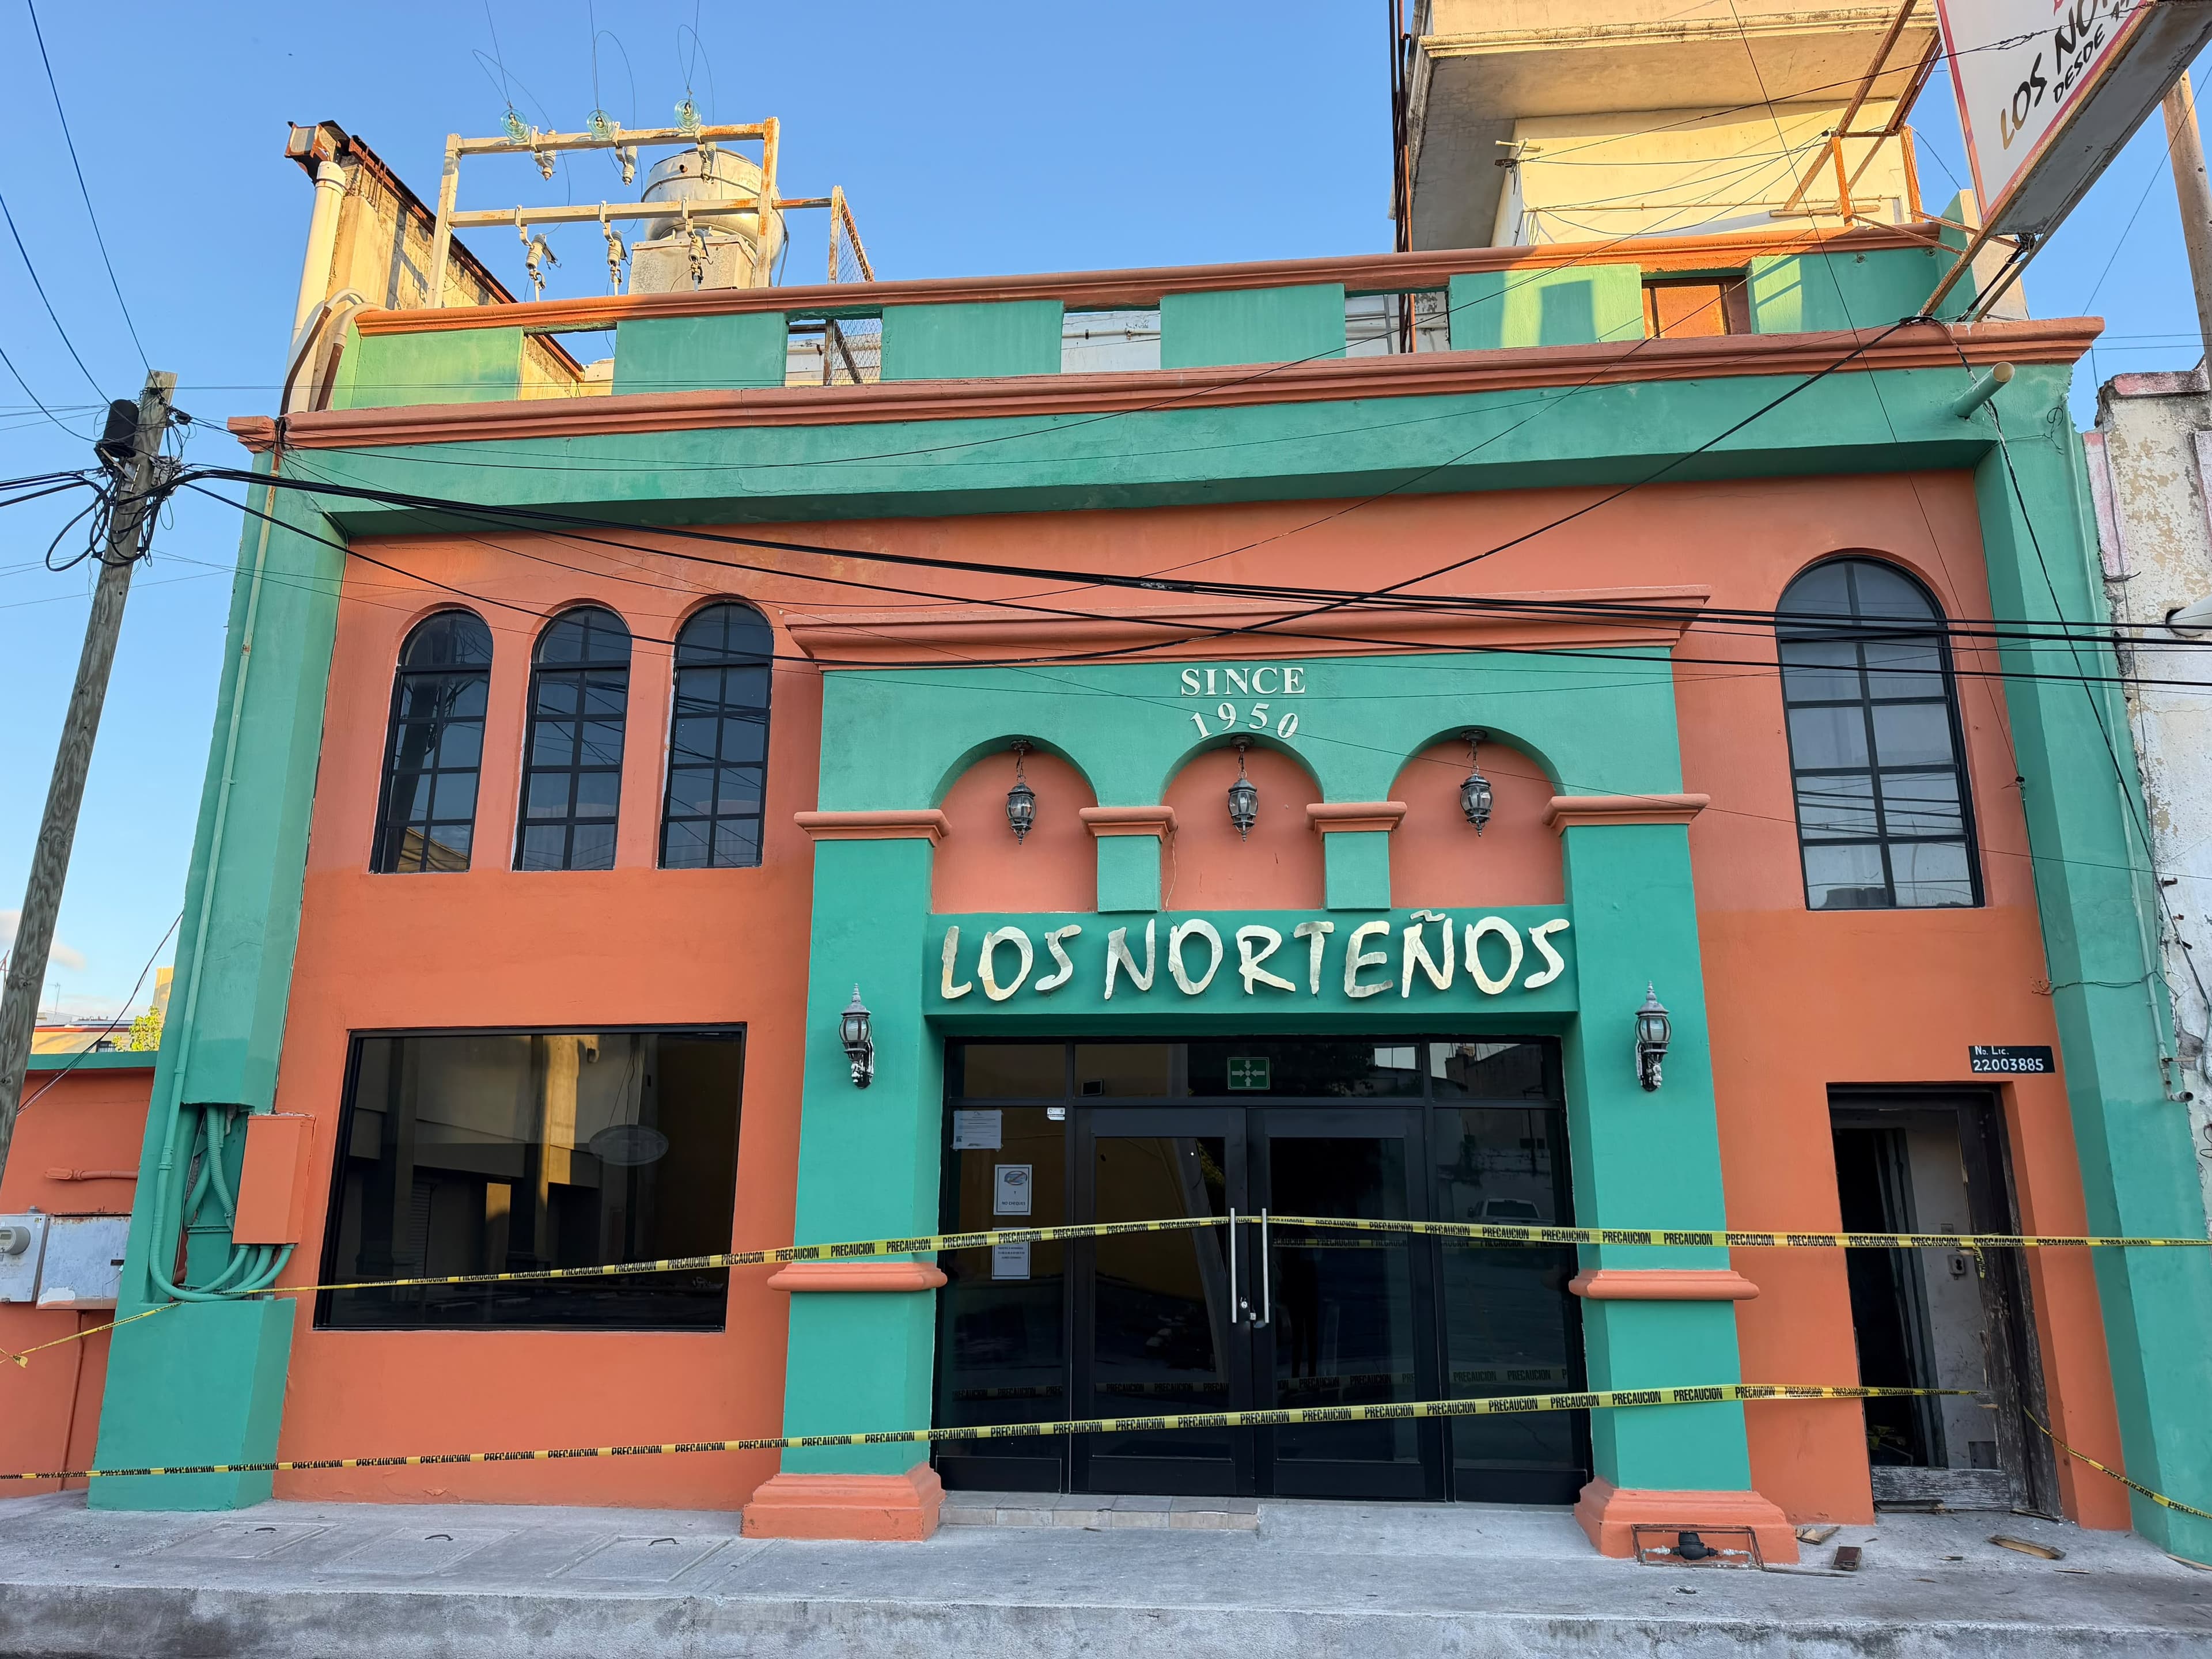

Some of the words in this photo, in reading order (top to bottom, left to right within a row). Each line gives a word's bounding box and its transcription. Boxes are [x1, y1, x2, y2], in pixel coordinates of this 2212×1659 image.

[2052, 23, 2105, 103] DESDE
[2001, 52, 2047, 150] LOS
[1181, 666, 1306, 696] SINCE
[1190, 702, 1299, 740] 1950
[941, 924, 1082, 1001] LOS
[1104, 908, 1570, 1001] NORTEÑOS
[1973, 1058, 2044, 1071] 22003885
[614, 1261, 657, 1272] PRECAUCION
[667, 1256, 710, 1269] PRECAUCION
[721, 1251, 764, 1266] PRECAUCION
[775, 1247, 819, 1261] PRECAUCION
[831, 1243, 875, 1257] PRECAUCION
[886, 1238, 931, 1252] PRECAUCION
[942, 1234, 987, 1249] PRECAUCION
[998, 1230, 1042, 1244] PRECAUCION
[1052, 1226, 1096, 1238] PRECAUCION
[1106, 1224, 1149, 1234] PRECAUCION
[1369, 1222, 1413, 1232] PRECAUCION
[1425, 1224, 1470, 1236] PRECAUCION
[1482, 1226, 1529, 1240] PRECAUCION
[1541, 1229, 1589, 1243] PRECAUCION
[1603, 1231, 1651, 1244] PRECAUCION
[1664, 1233, 1713, 1245] PRECAUCION
[1725, 1234, 1775, 1246] PRECAUCION
[1787, 1235, 1836, 1247] PRECAUCION
[1849, 1236, 1899, 1247] PRECAUCION
[1911, 1237, 1961, 1247] PRECAUCION
[292, 1460, 343, 1469] PRECAUCION
[356, 1457, 407, 1466] PRECAUCION
[420, 1454, 471, 1464] PRECAUCION
[484, 1451, 535, 1461] PRECAUCION
[548, 1448, 598, 1458] PRECAUCION
[611, 1445, 662, 1455] PRECAUCION
[675, 1442, 725, 1452] PRECAUCION
[738, 1439, 789, 1449] PRECAUCION
[802, 1435, 851, 1446] PRECAUCION
[865, 1432, 915, 1443] PRECAUCION
[928, 1429, 978, 1440] PRECAUCION
[991, 1425, 1040, 1437] PRECAUCION
[1053, 1421, 1103, 1433] PRECAUCION
[1116, 1418, 1165, 1431] PRECAUCION
[1178, 1415, 1227, 1427] PRECAUCION
[1240, 1411, 1290, 1425] PRECAUCION
[1302, 1408, 1351, 1421] PRECAUCION
[1365, 1404, 1414, 1418] PRECAUCION
[1426, 1401, 1476, 1415] PRECAUCION
[1488, 1397, 1538, 1412] PRECAUCION
[1550, 1395, 1600, 1408] PRECAUCION
[1612, 1391, 1661, 1405] PRECAUCION
[1673, 1388, 1723, 1402] PRECAUCION
[1735, 1387, 1775, 1398] PRECAUCION
